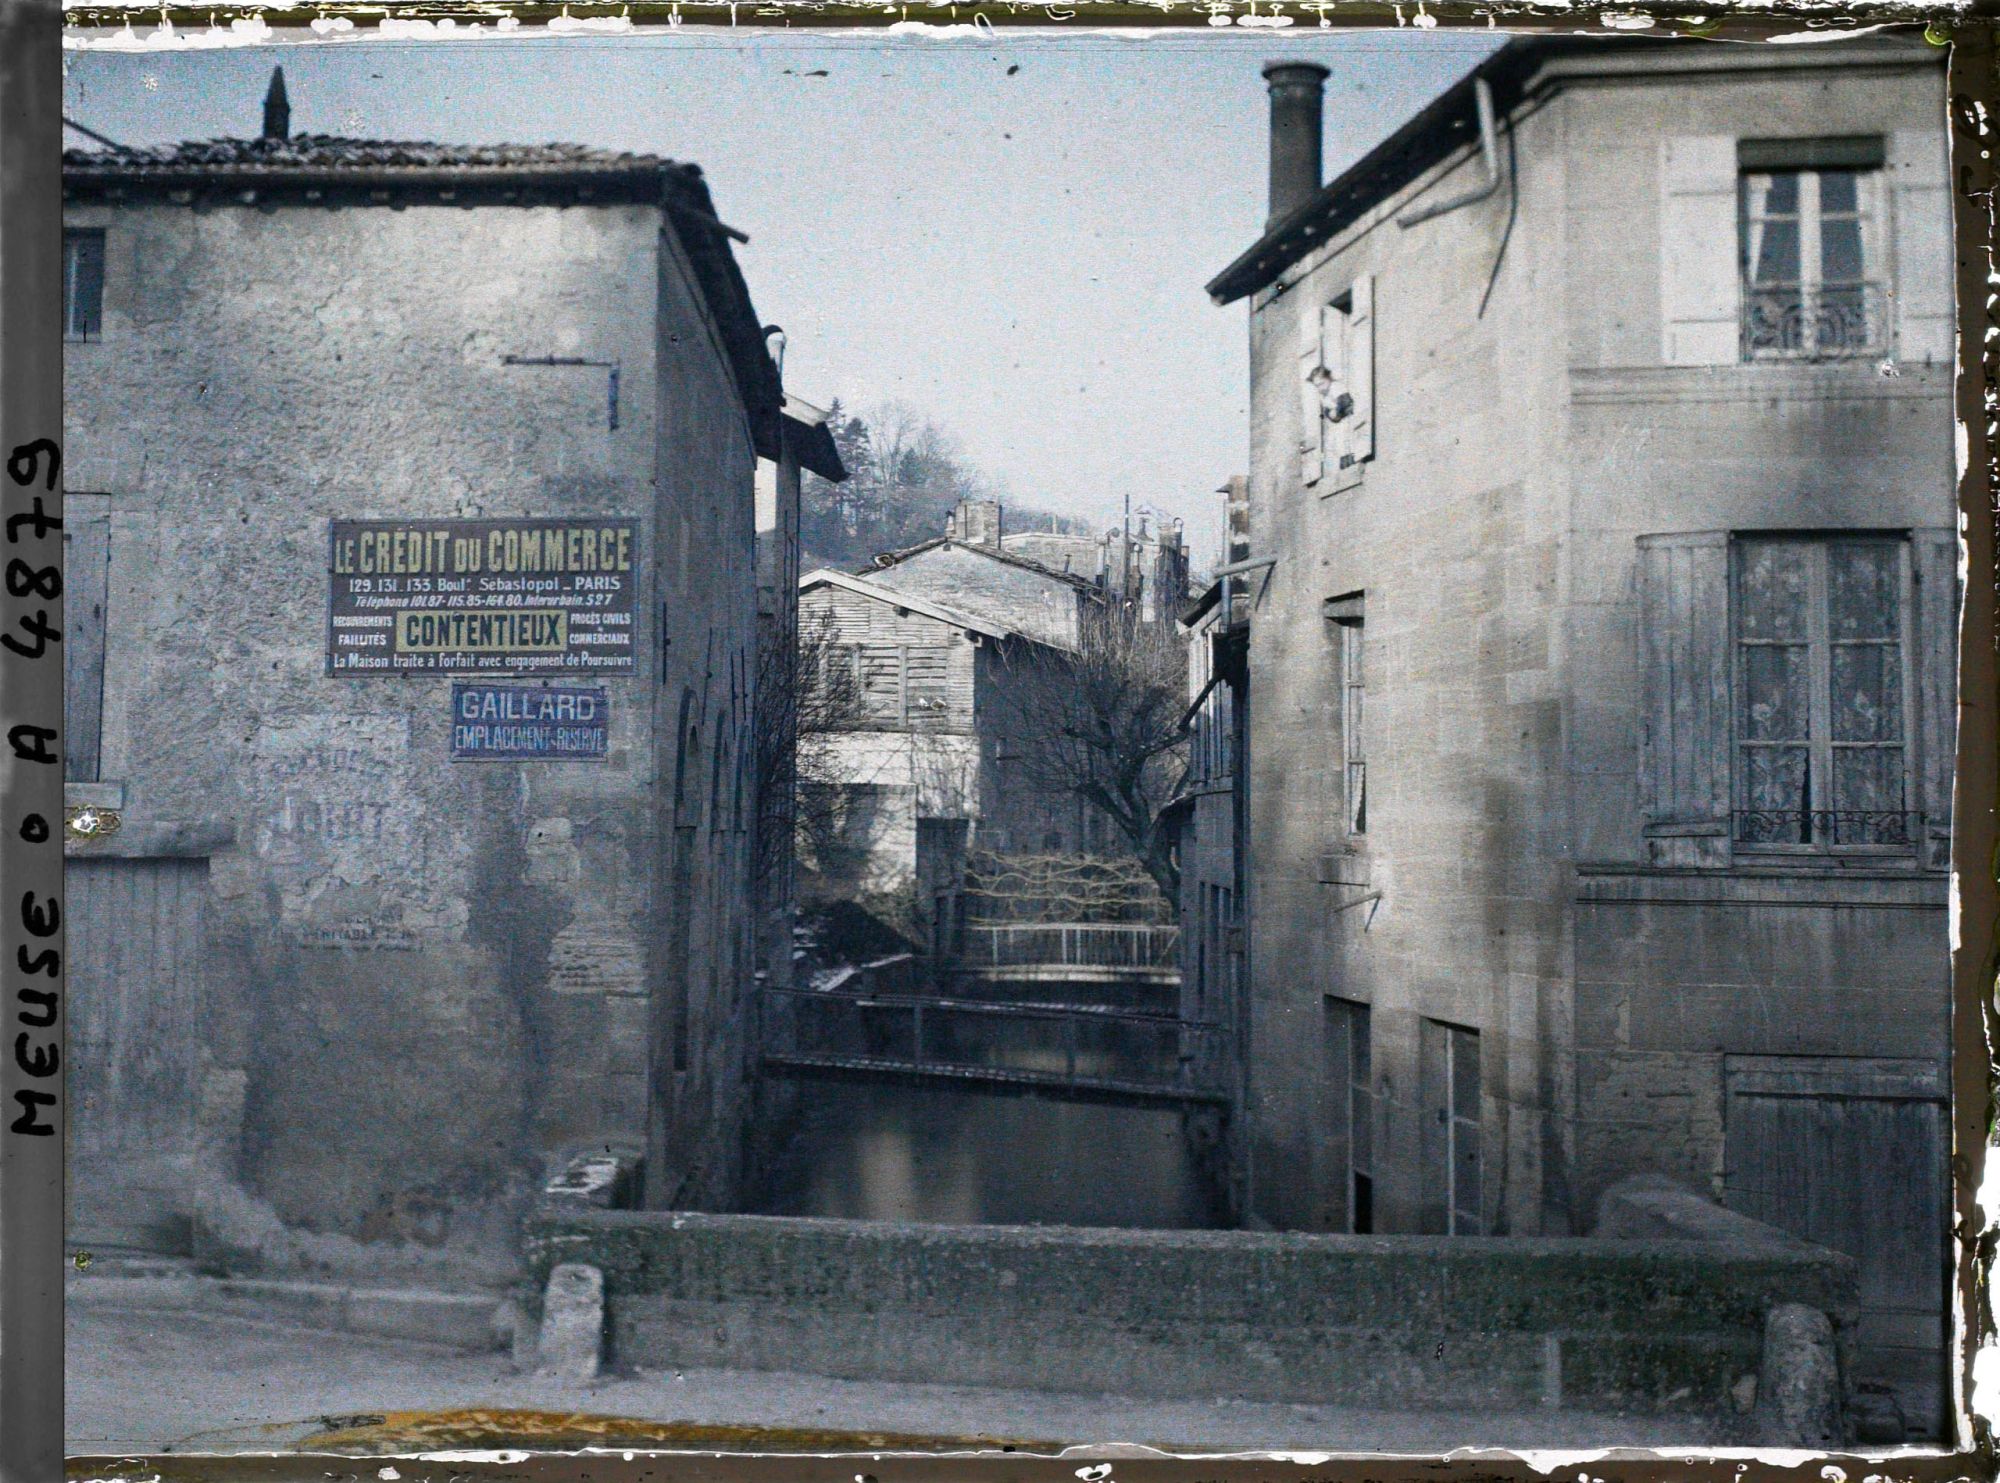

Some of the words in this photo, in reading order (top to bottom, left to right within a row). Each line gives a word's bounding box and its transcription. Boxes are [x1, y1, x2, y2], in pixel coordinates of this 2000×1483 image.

[1, 437, 62, 661] 4879
[335, 539, 354, 574] LE
[455, 538, 482, 573] DU
[488, 528, 632, 572] COMMERCE
[575, 576, 621, 591] PARIS
[406, 614, 561, 647] CONTENTIEUX
[334, 653, 346, 668] La
[348, 653, 389, 668] Maison
[393, 653, 424, 667] traite
[427, 654, 435, 667] à
[439, 652, 475, 667] forfait
[478, 655, 501, 667] avec
[505, 654, 564, 671] engagement
[566, 653, 580, 667] de
[581, 651, 632, 667] Poursuivre
[462, 691, 596, 721] GAILLARD
[8, 724, 58, 765] A
[455, 725, 551, 750] EMPLACEMENT
[12, 891, 60, 1137] MEUSE
